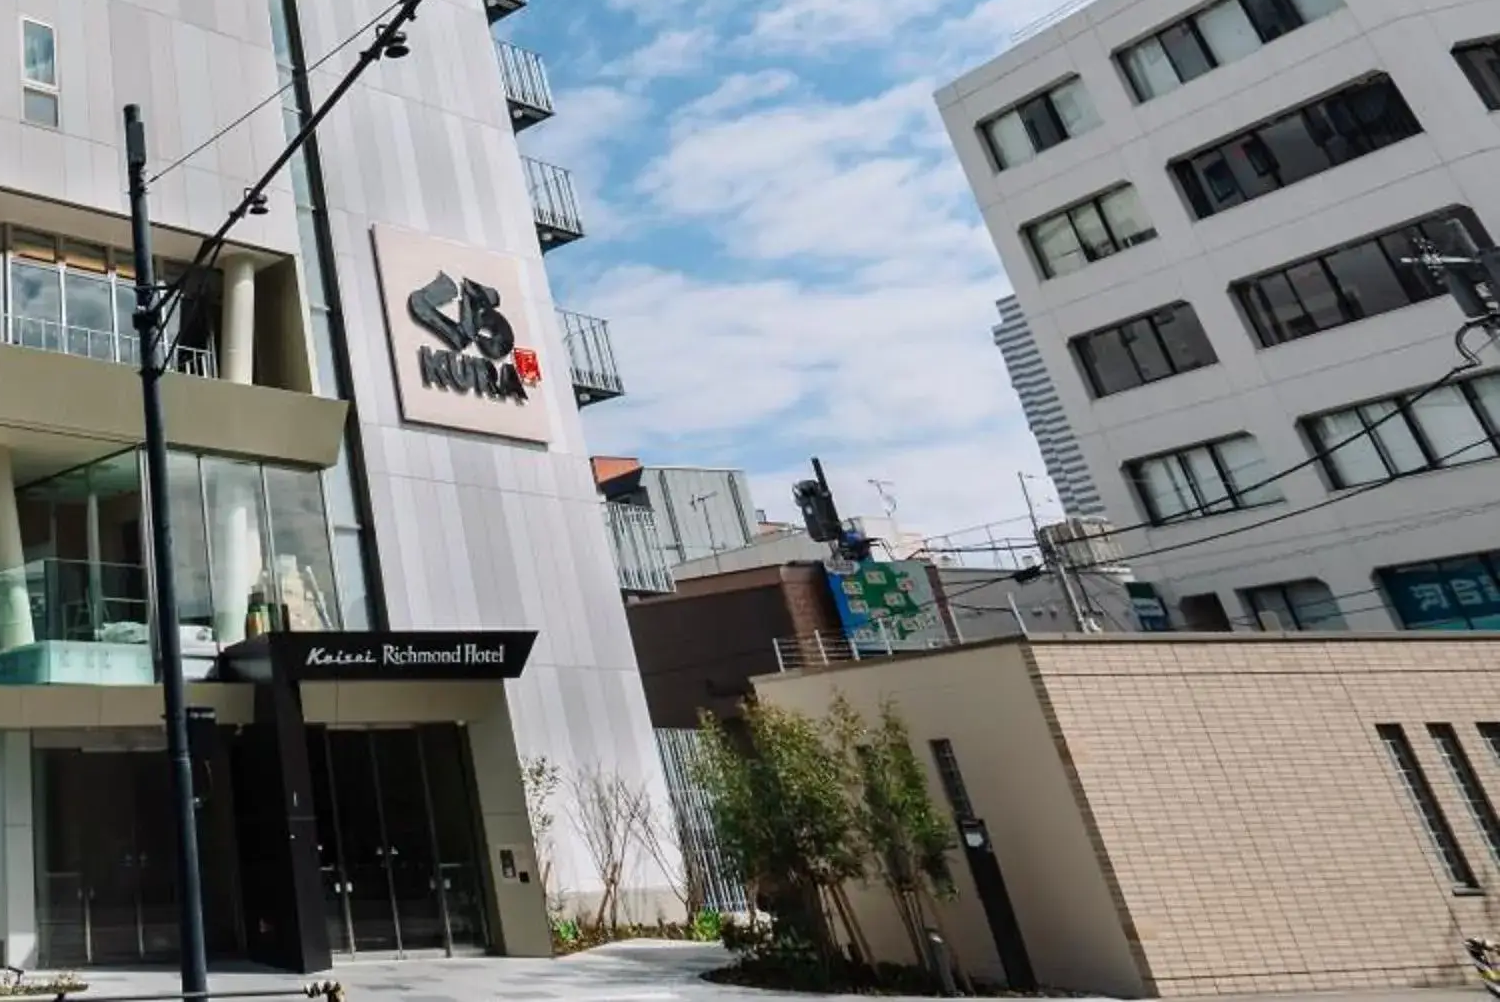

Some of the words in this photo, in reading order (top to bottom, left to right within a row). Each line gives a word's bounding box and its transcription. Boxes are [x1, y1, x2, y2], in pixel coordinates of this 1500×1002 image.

[418, 345, 528, 405] KURA
[382, 644, 461, 665] Richmond
[464, 643, 505, 665] Hotel
